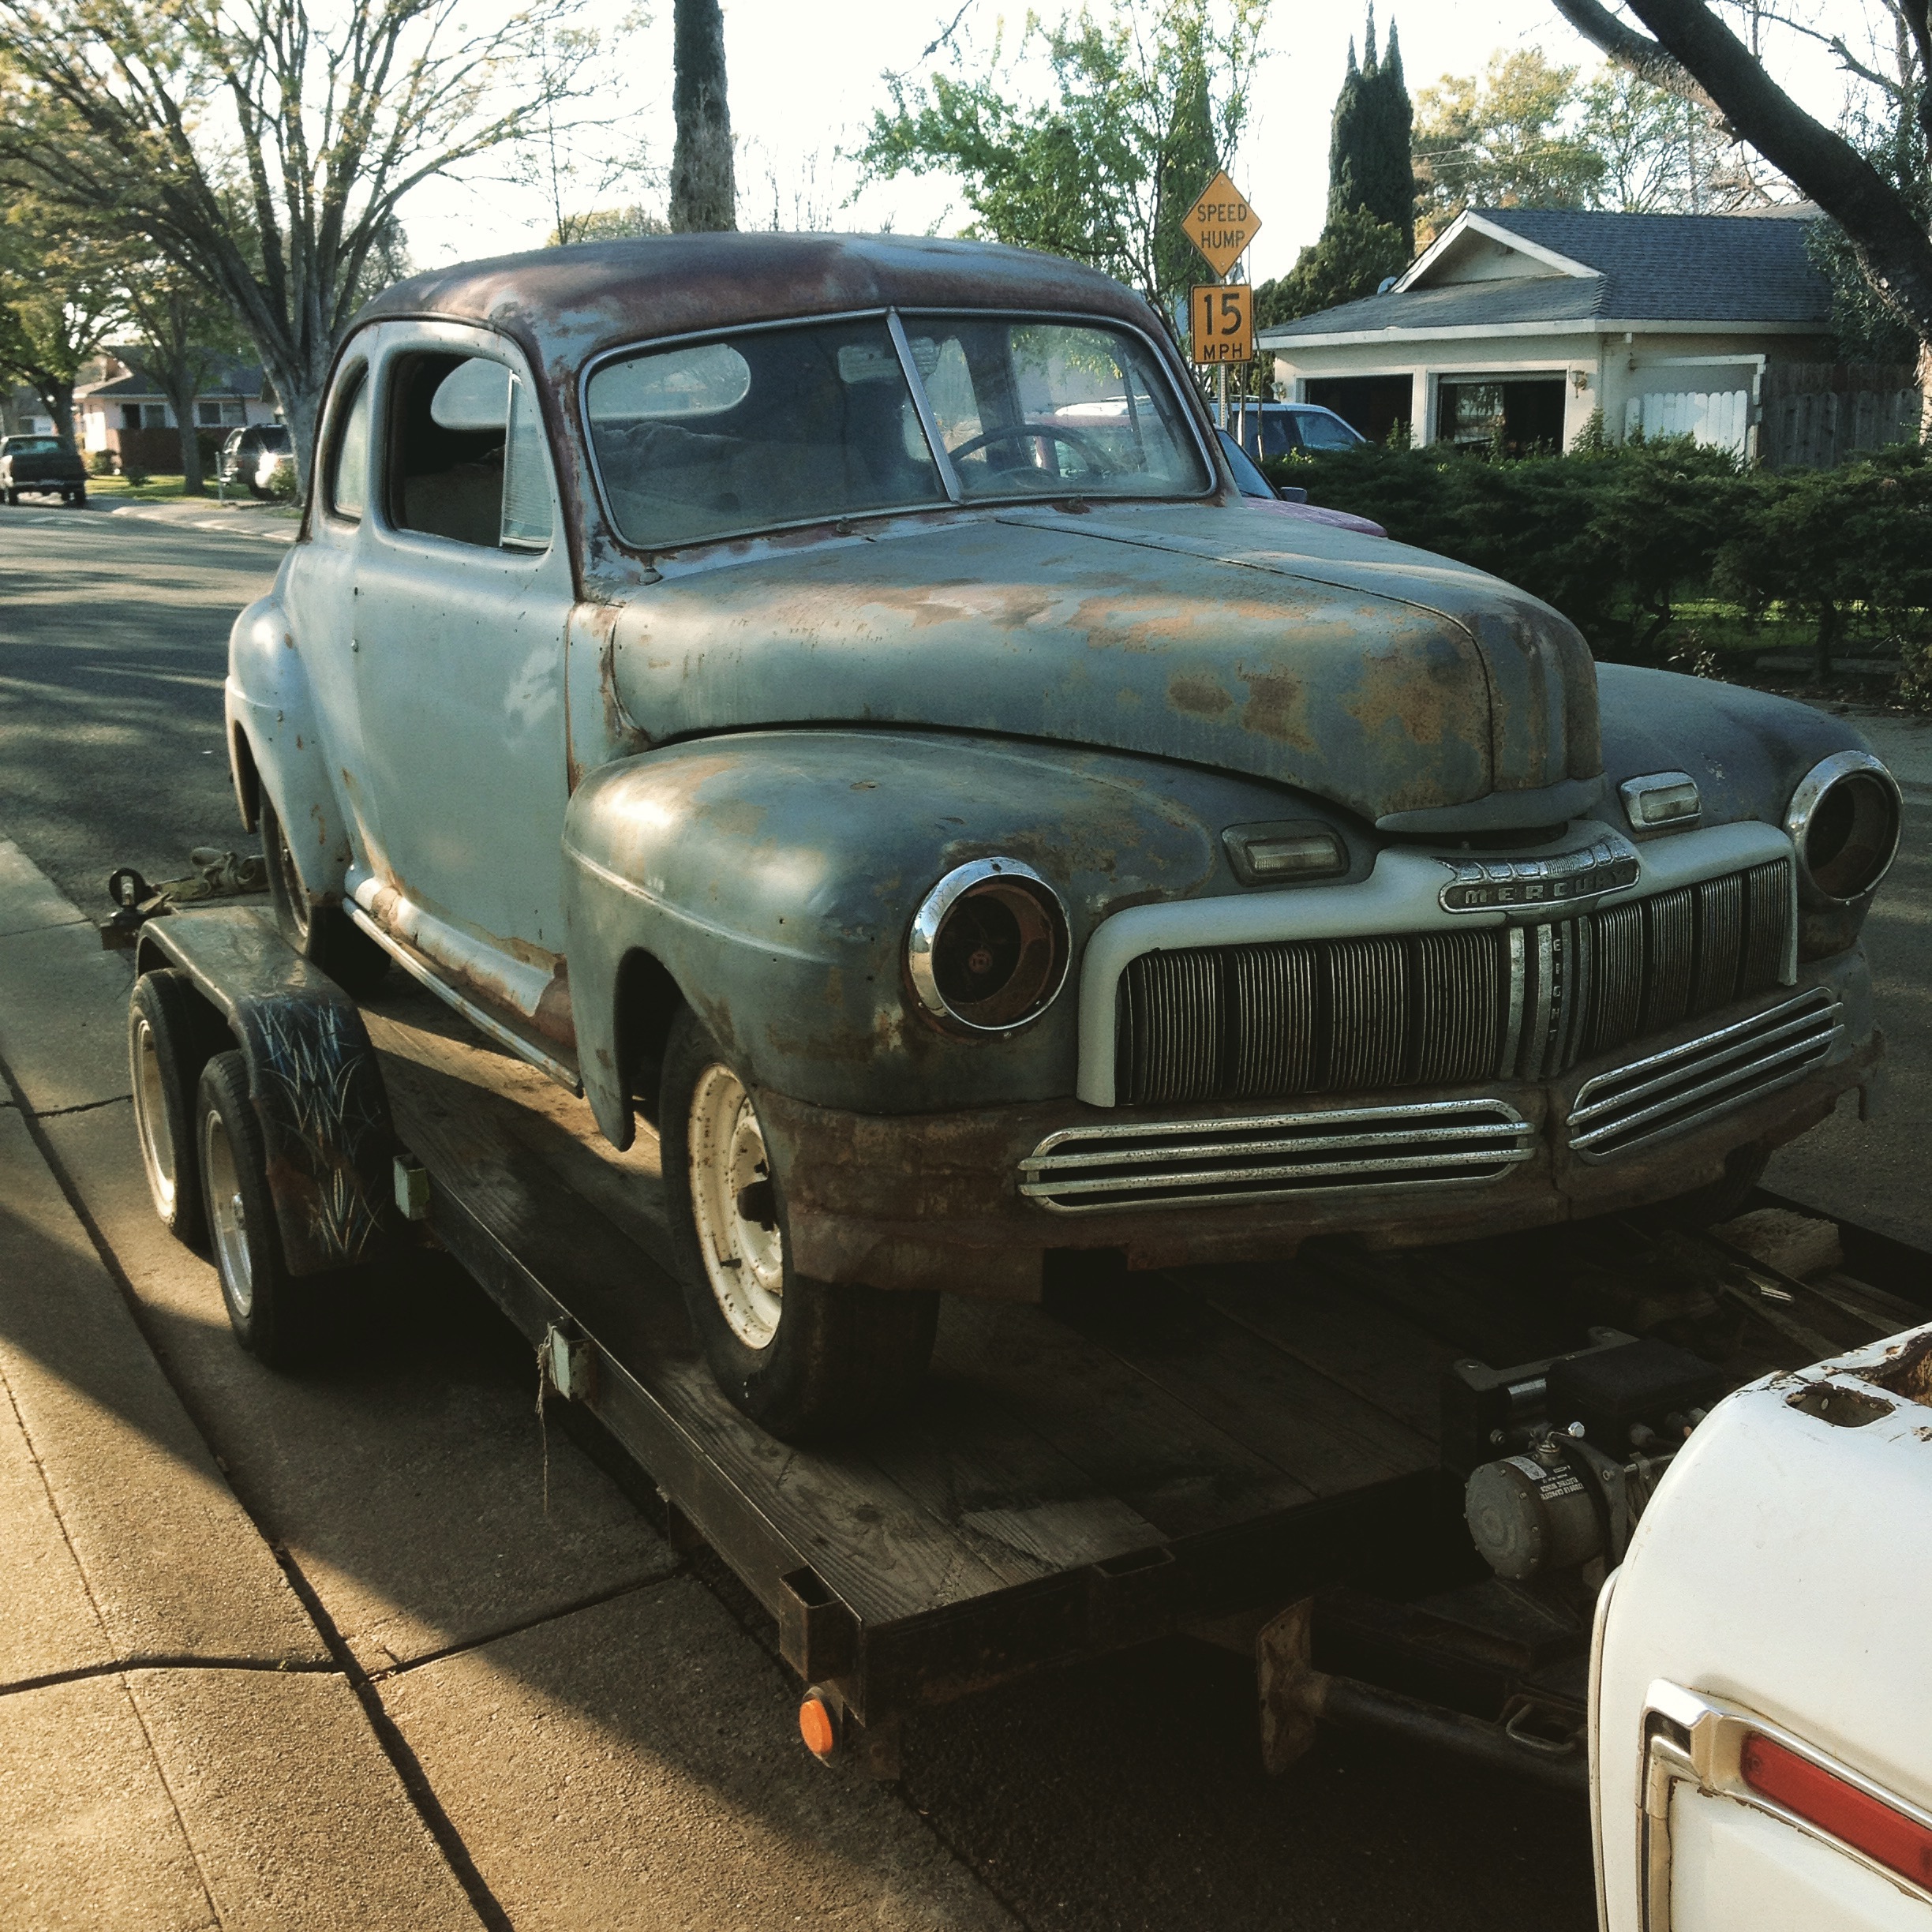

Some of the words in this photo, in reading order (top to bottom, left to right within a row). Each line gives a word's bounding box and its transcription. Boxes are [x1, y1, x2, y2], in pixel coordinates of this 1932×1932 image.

[1197, 204, 1247, 223] SPEED
[1201, 230, 1245, 249] HUMP
[1204, 293, 1242, 335] 15
[1204, 343, 1243, 361] MPH
[1465, 869, 1626, 904] MERCURY
[1549, 938, 1561, 1042] EIGHT
